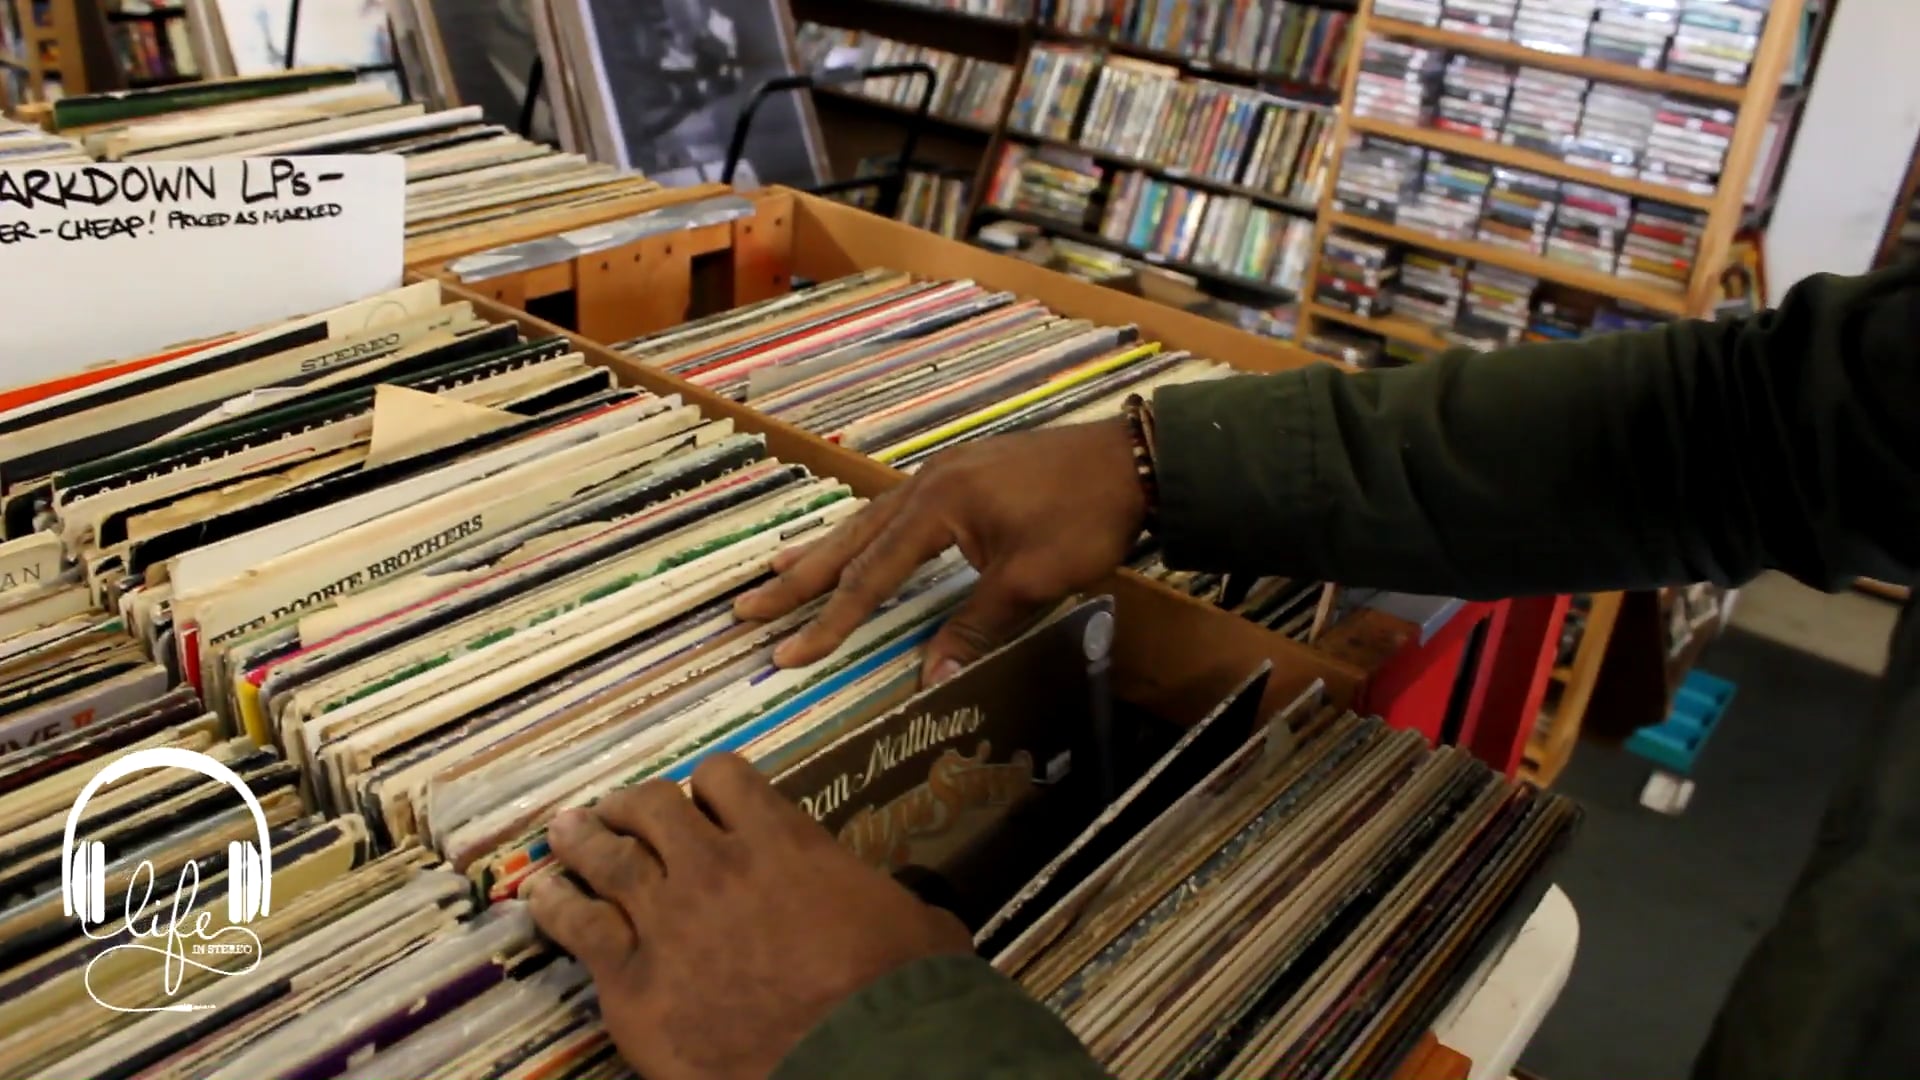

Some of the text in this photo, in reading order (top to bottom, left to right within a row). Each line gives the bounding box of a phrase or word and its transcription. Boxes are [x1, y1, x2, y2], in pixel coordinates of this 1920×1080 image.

[234, 211, 259, 225] AS
[262, 203, 343, 225] MARKED
[301, 331, 400, 373] STEREO
[367, 514, 483, 580] BROTHERS
